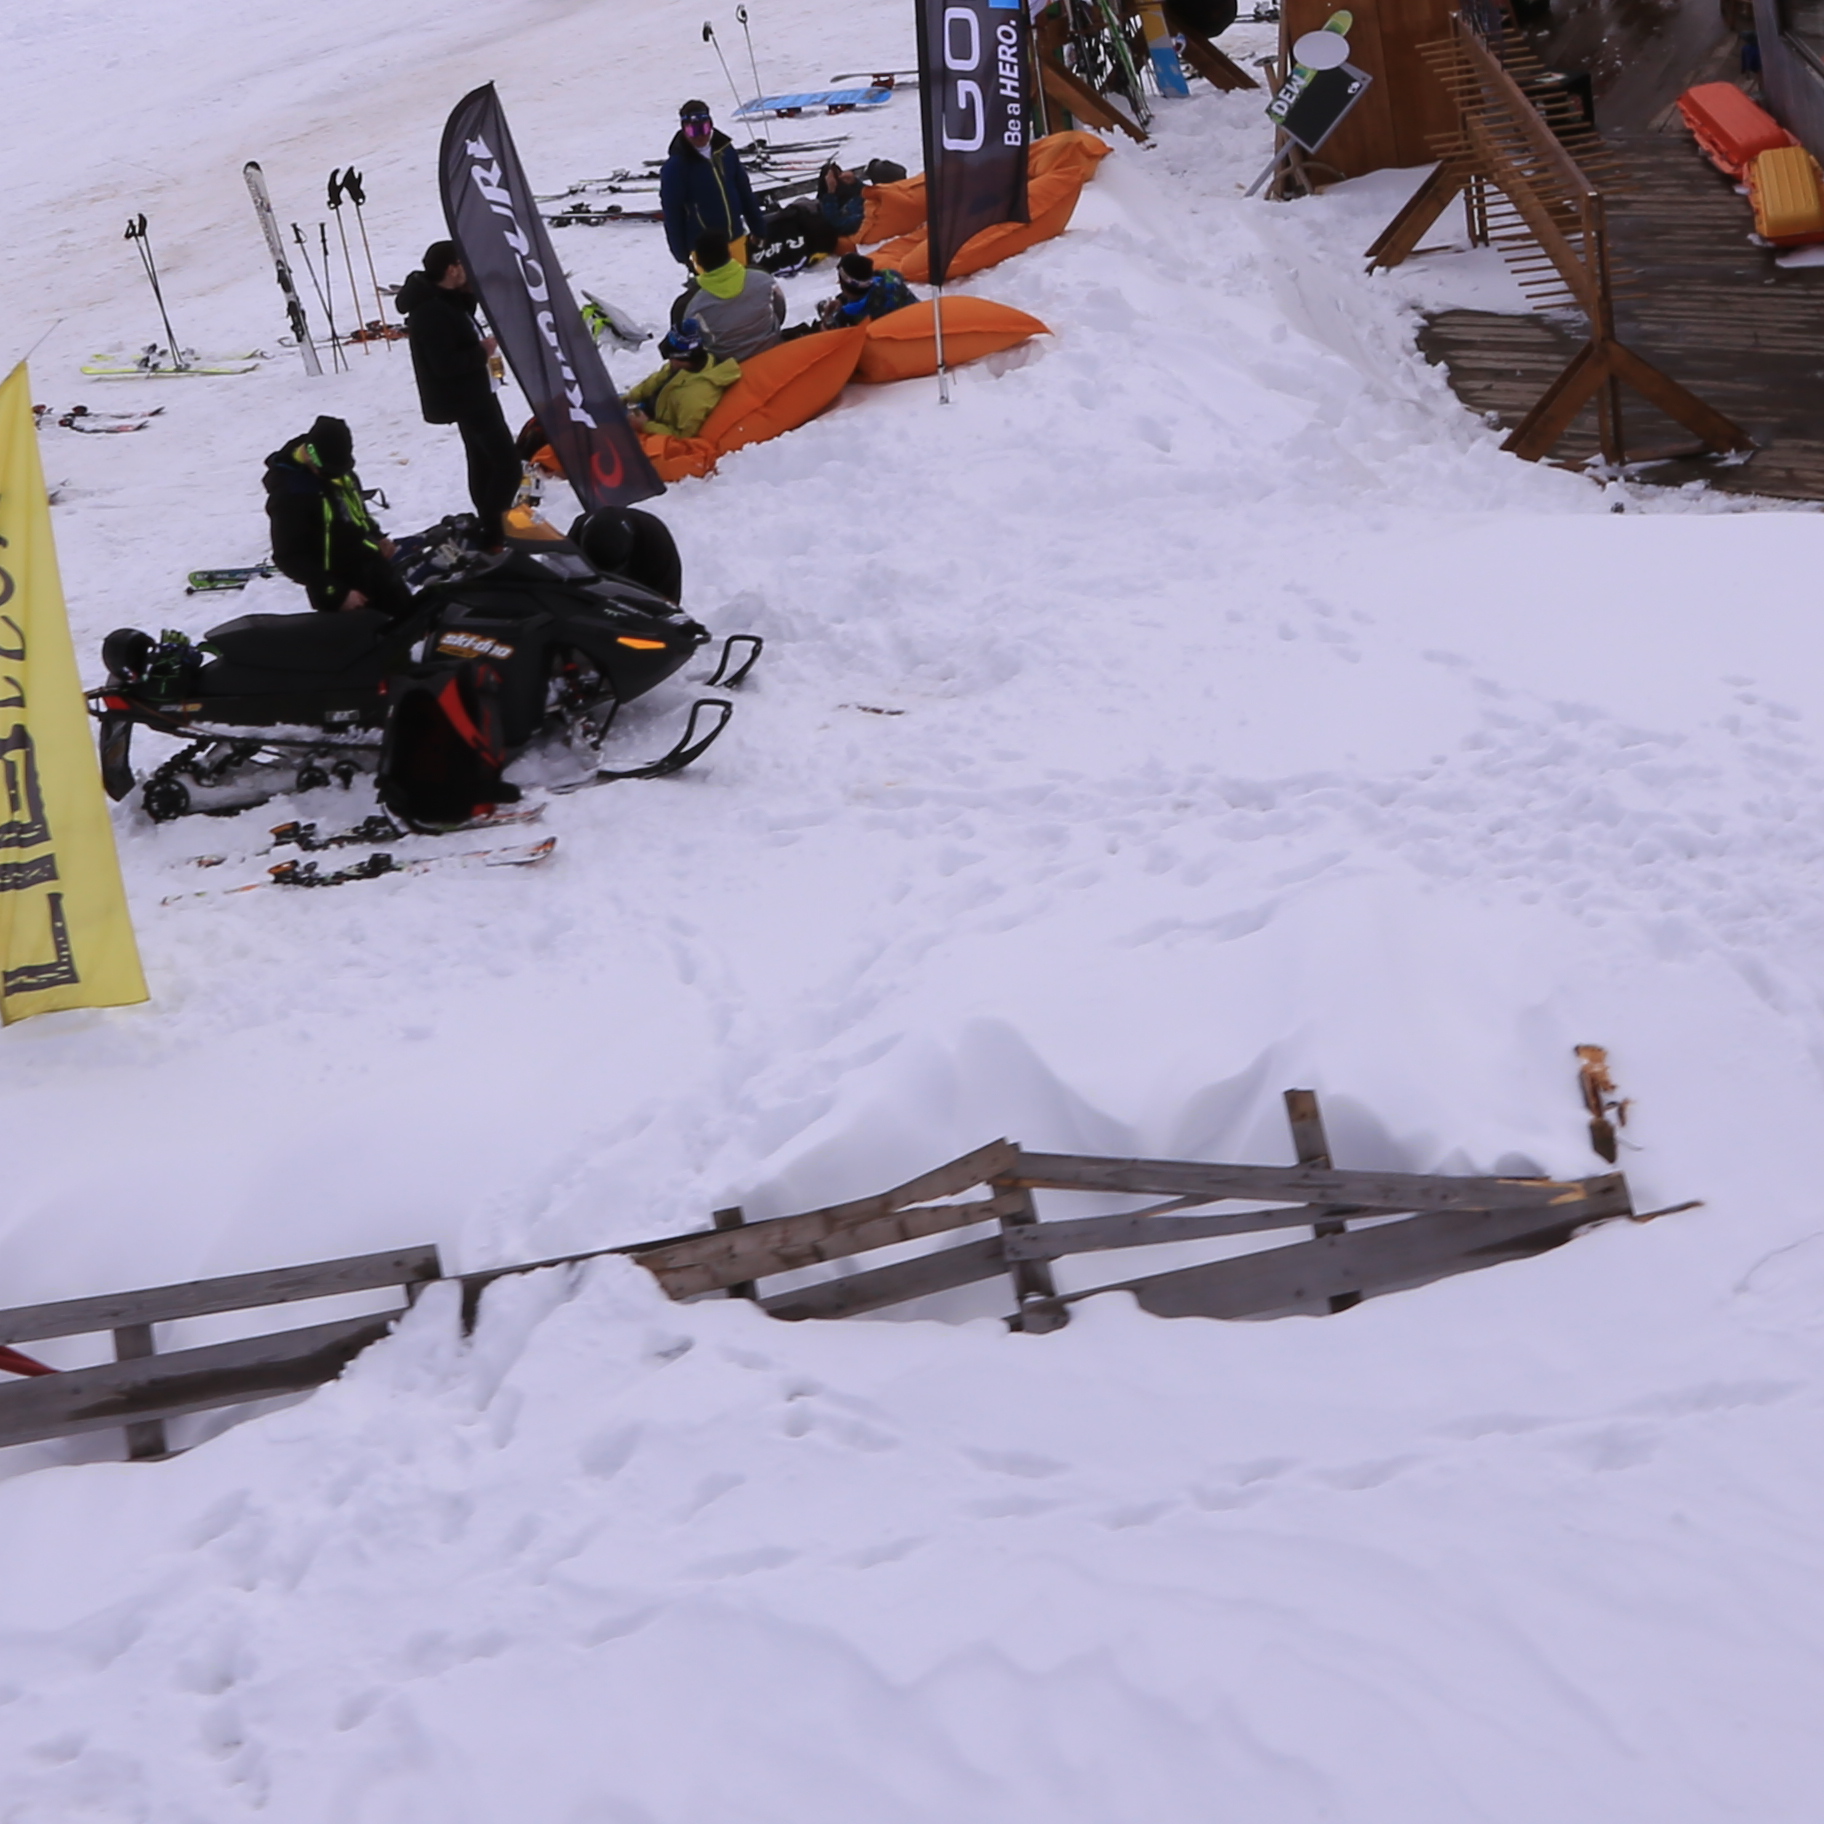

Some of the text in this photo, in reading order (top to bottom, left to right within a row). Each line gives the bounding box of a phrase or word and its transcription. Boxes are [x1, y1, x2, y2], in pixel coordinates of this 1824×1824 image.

[996, 18, 1022, 147] Be a HERO.
[1271, 74, 1307, 117] DEW
